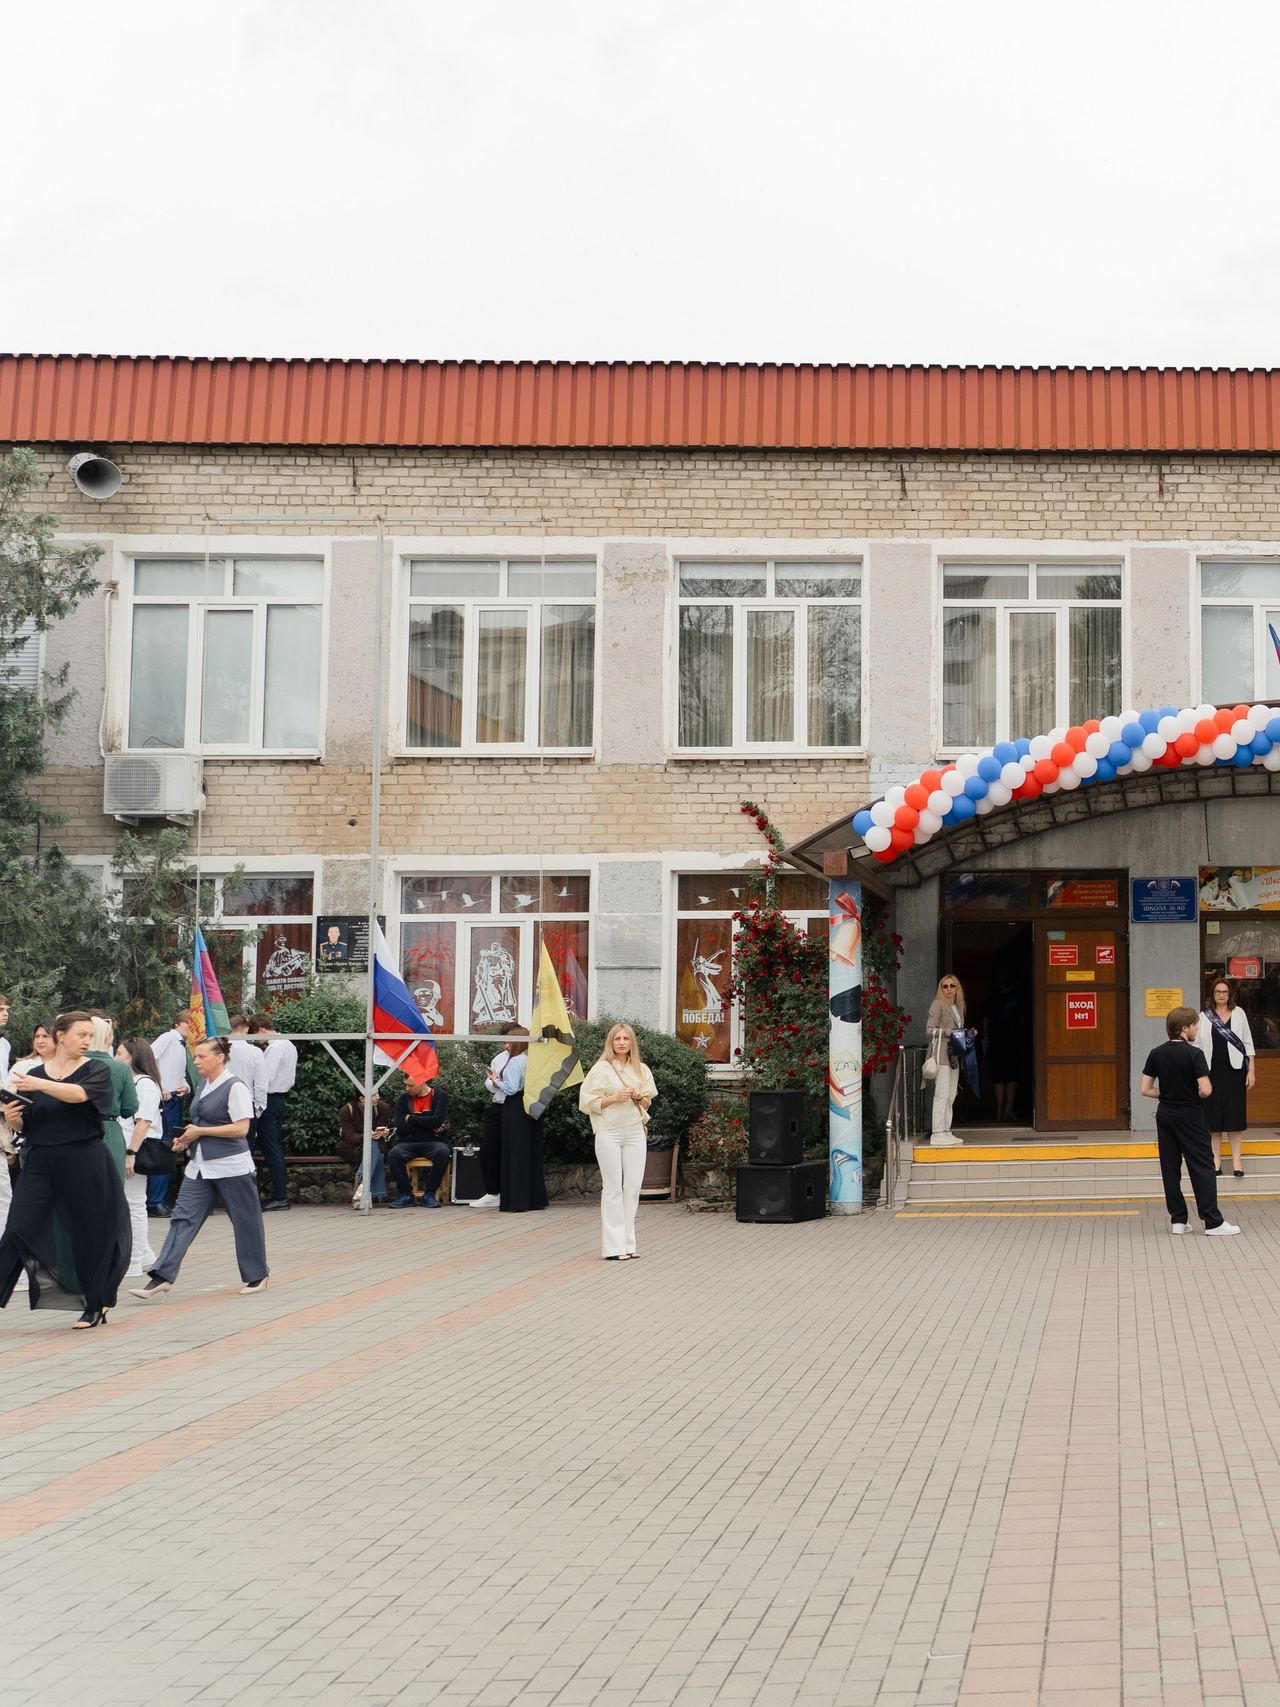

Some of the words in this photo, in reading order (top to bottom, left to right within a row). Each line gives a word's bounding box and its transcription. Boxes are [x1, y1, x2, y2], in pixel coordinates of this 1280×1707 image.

[1069, 1001, 1094, 1010] ВХОД
[682, 1012, 725, 1025] ПОБЕДА!
[1074, 1012, 1089, 1020] №1
